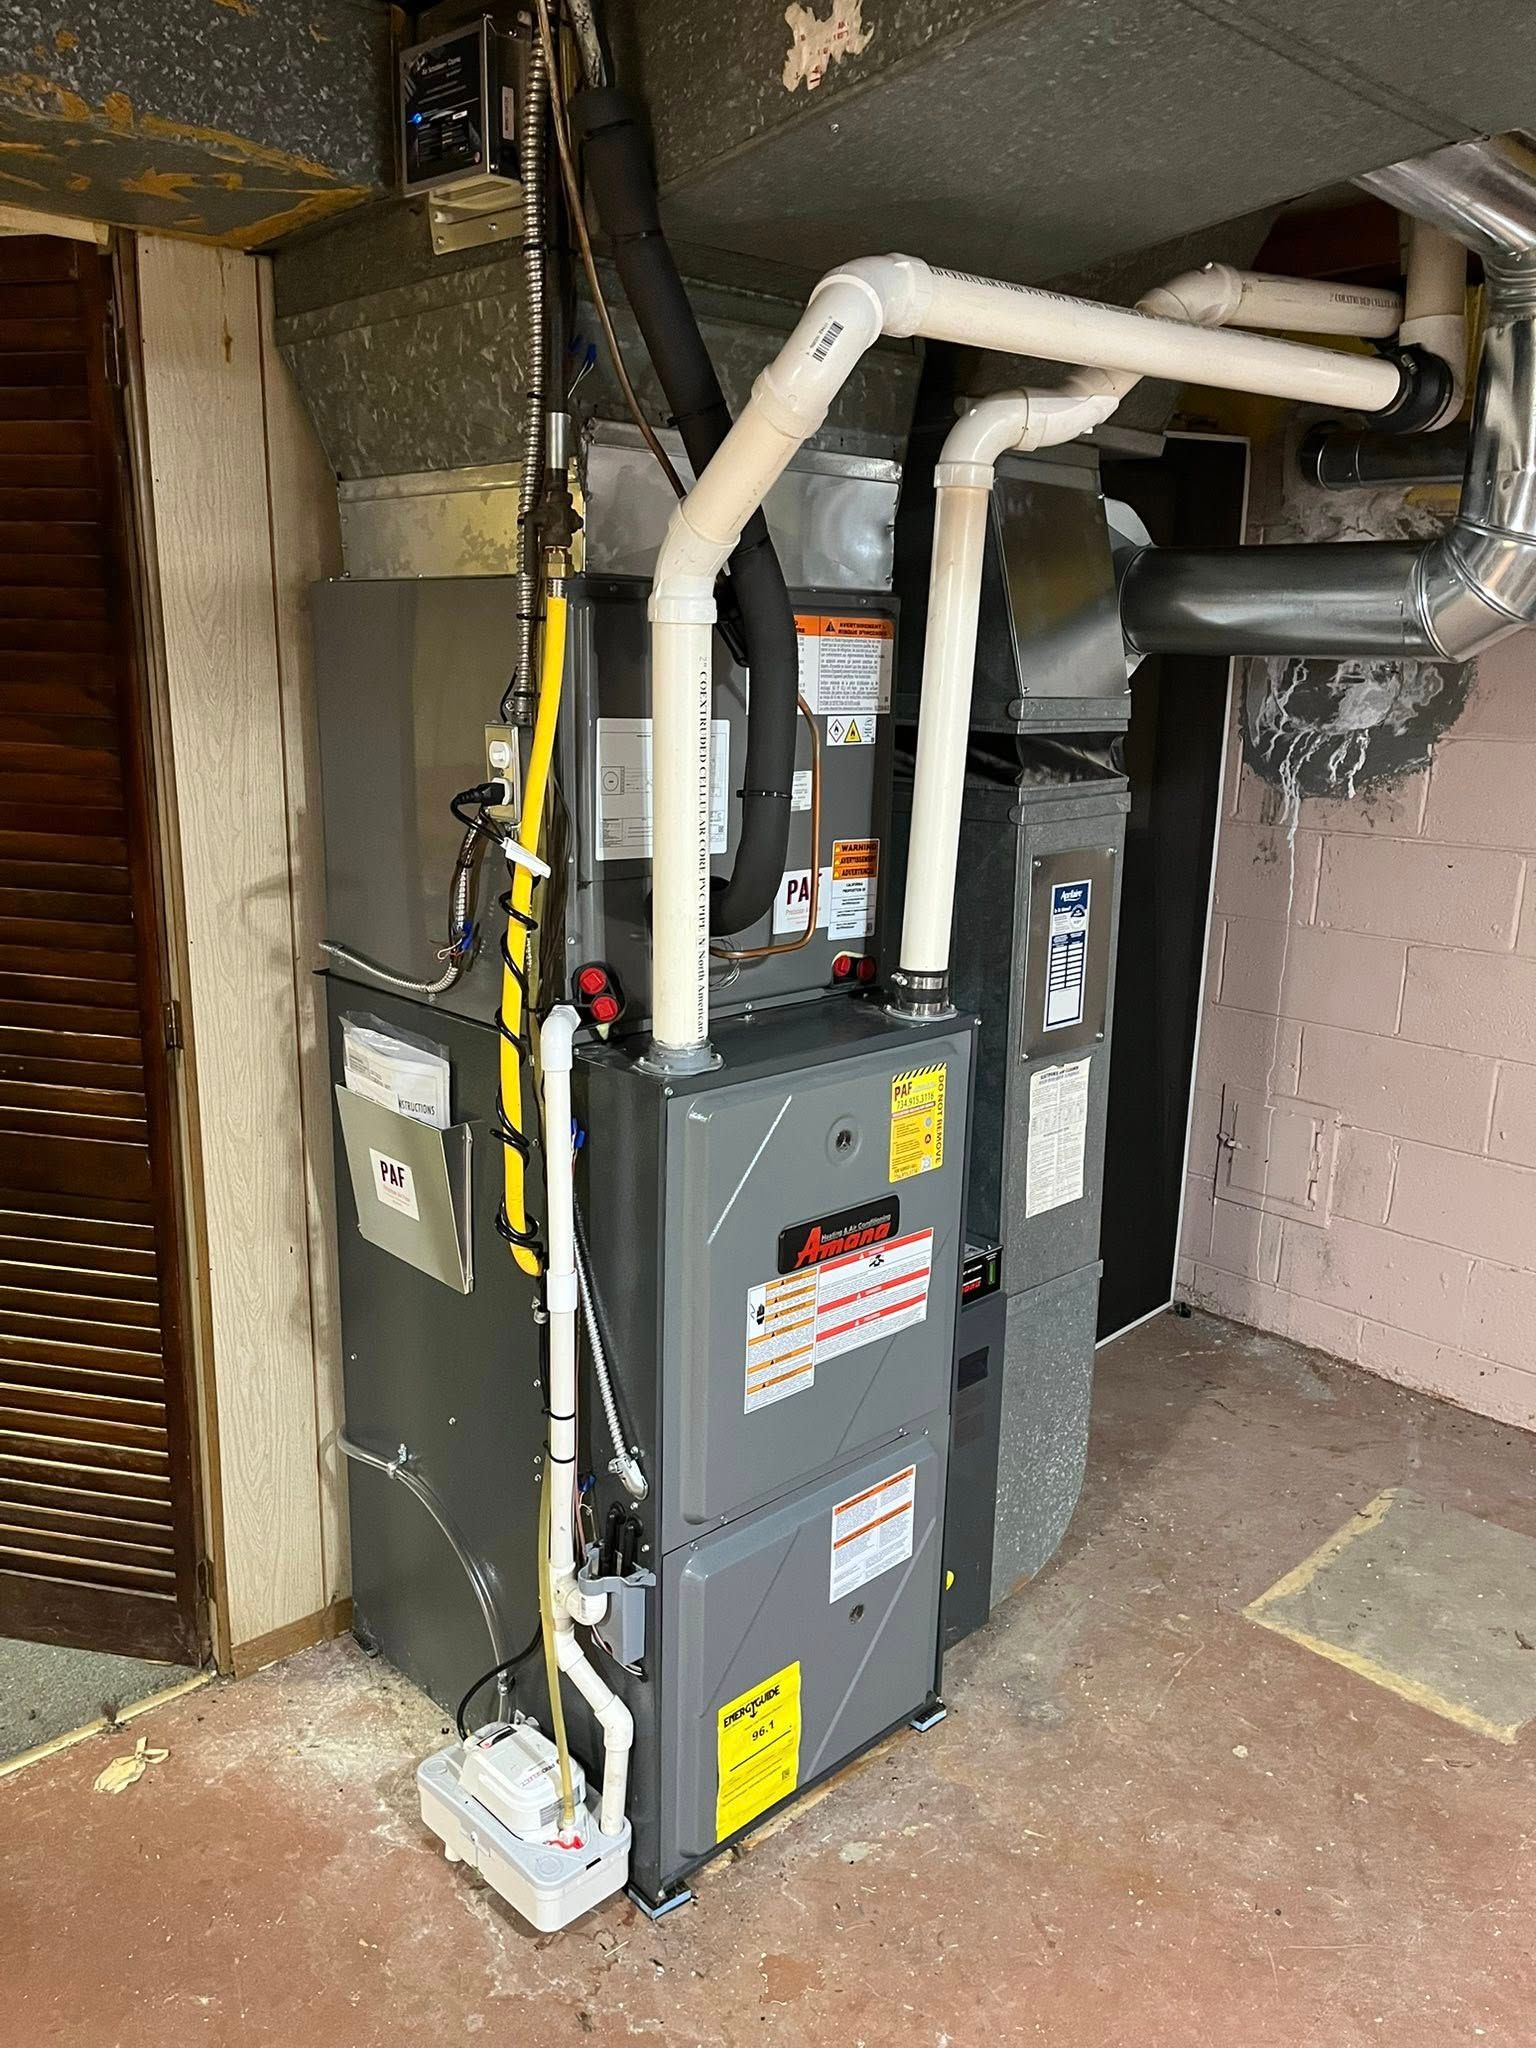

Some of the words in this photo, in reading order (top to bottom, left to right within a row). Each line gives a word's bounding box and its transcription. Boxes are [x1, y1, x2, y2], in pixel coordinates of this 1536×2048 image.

[698, 671, 708, 764] COEXTRUDED
[698, 766, 707, 837] CELLULAR
[698, 839, 707, 875] CORE
[841, 843, 878, 852] WARNING
[697, 877, 706, 903] PVC
[697, 905, 706, 932] PIPE
[697, 950, 706, 982] North
[696, 984, 706, 1034] American
[894, 1081, 913, 1101] PAF
[937, 1074, 944, 1092] DO
[935, 1118, 944, 1164] REMOVE
[380, 1160, 406, 1190] PAF
[821, 1228, 843, 1243] Heating
[843, 1226, 849, 1236] &
[849, 1223, 858, 1234] Air
[858, 1214, 892, 1230] Conditioning
[793, 1223, 892, 1269] Amana
[751, 1719, 776, 1742] 96.1
